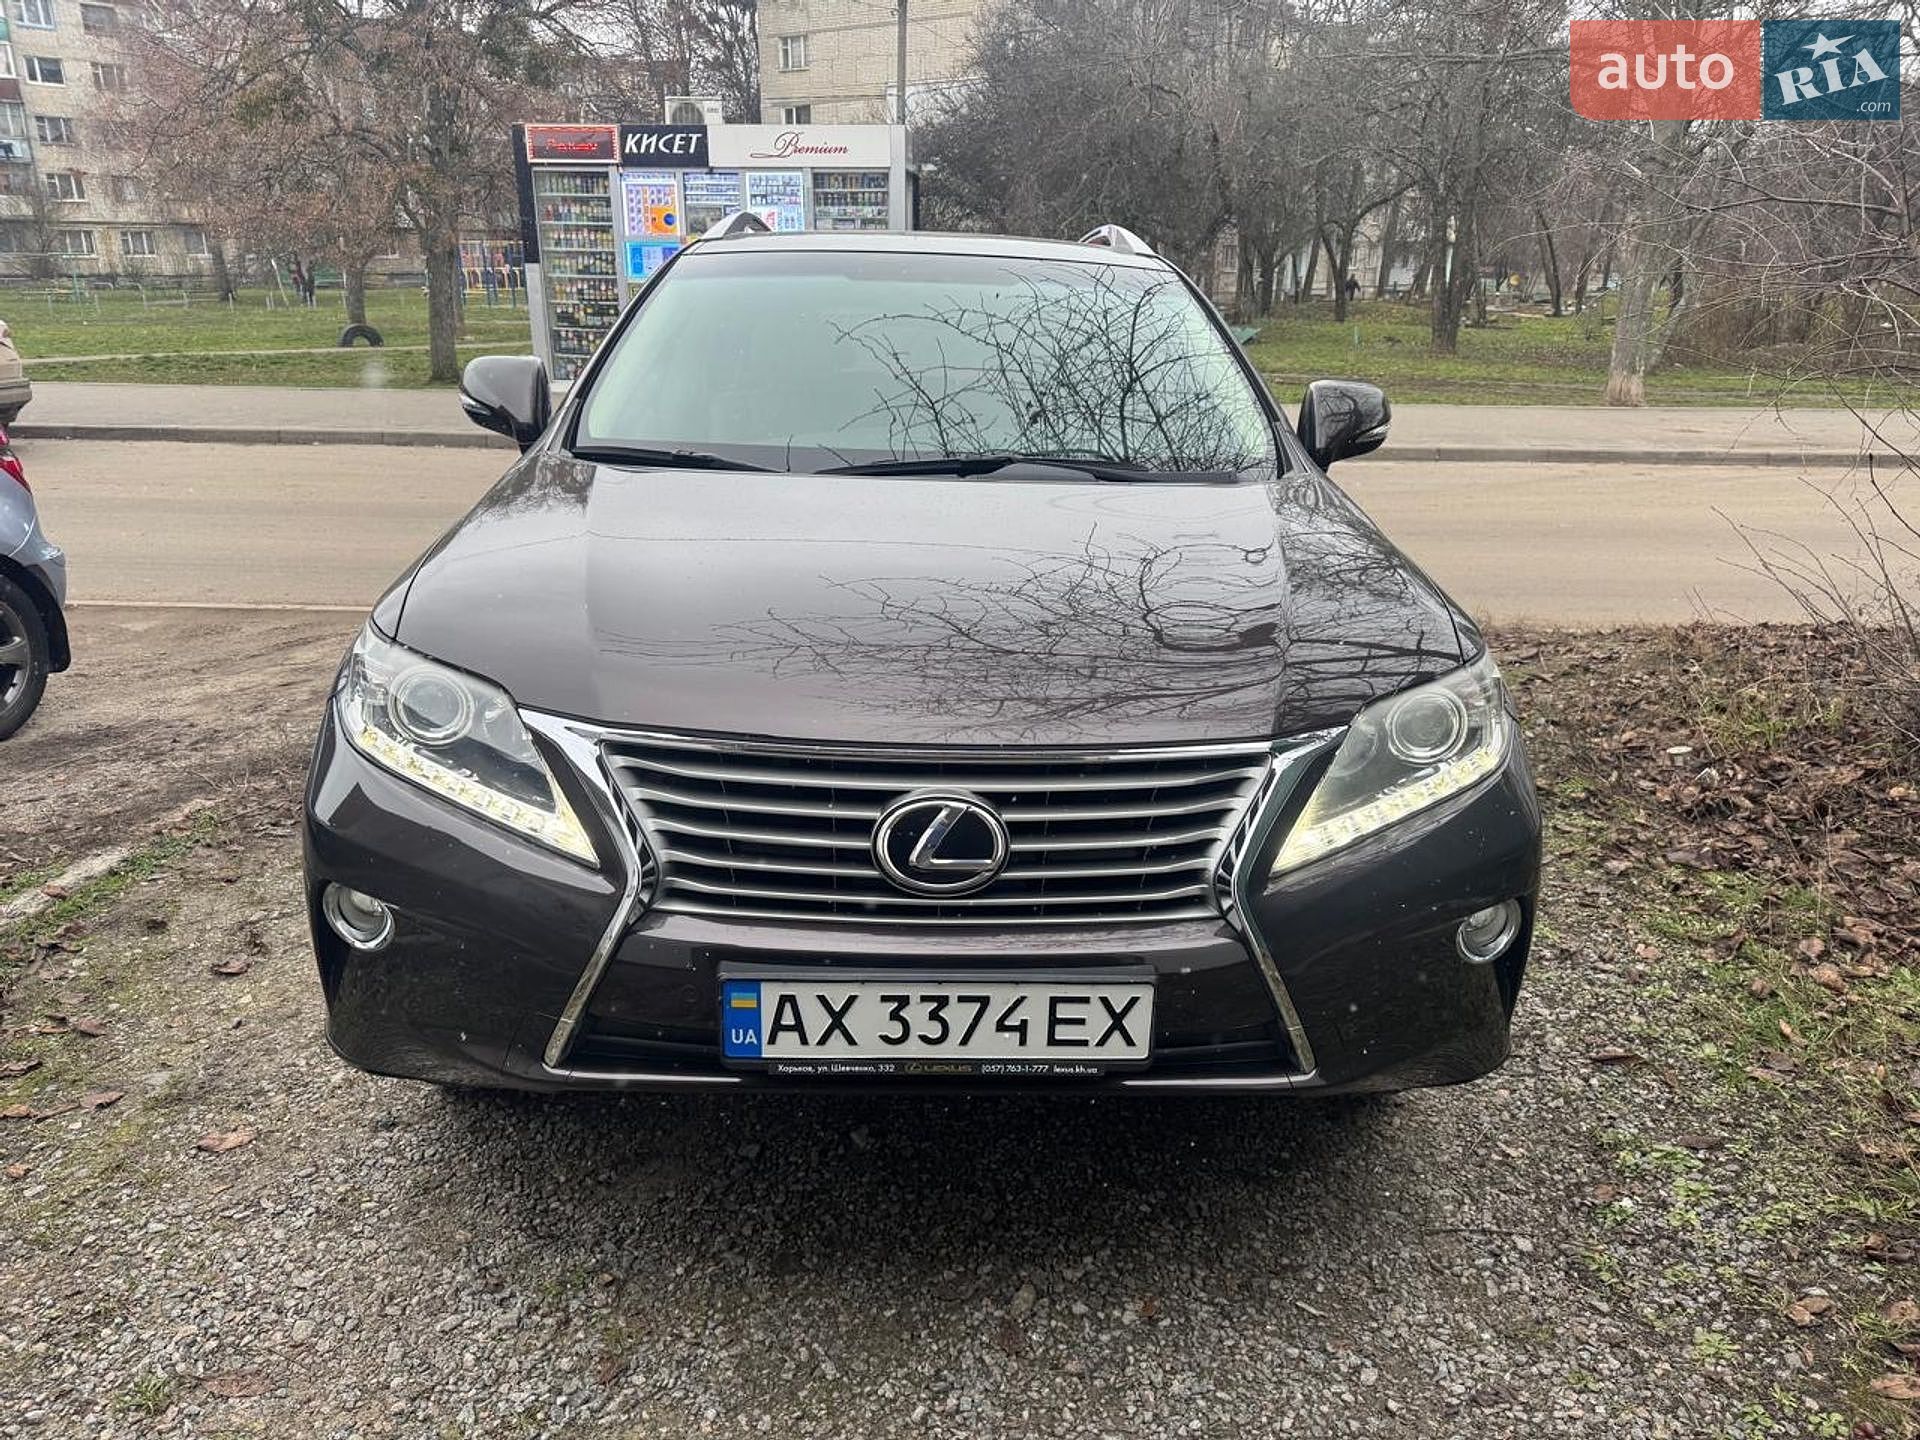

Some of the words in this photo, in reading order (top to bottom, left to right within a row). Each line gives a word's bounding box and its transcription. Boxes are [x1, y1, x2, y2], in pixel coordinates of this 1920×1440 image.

[624, 133, 702, 153] КИСЕТ
[750, 131, 848, 158] Premium
[767, 994, 858, 1046] AX
[878, 994, 1028, 1046] 3374
[1046, 995, 1141, 1047] EX
[731, 1029, 757, 1044] UA
[878, 1064, 895, 1072] 332
[981, 1064, 1005, 1075] (057)
